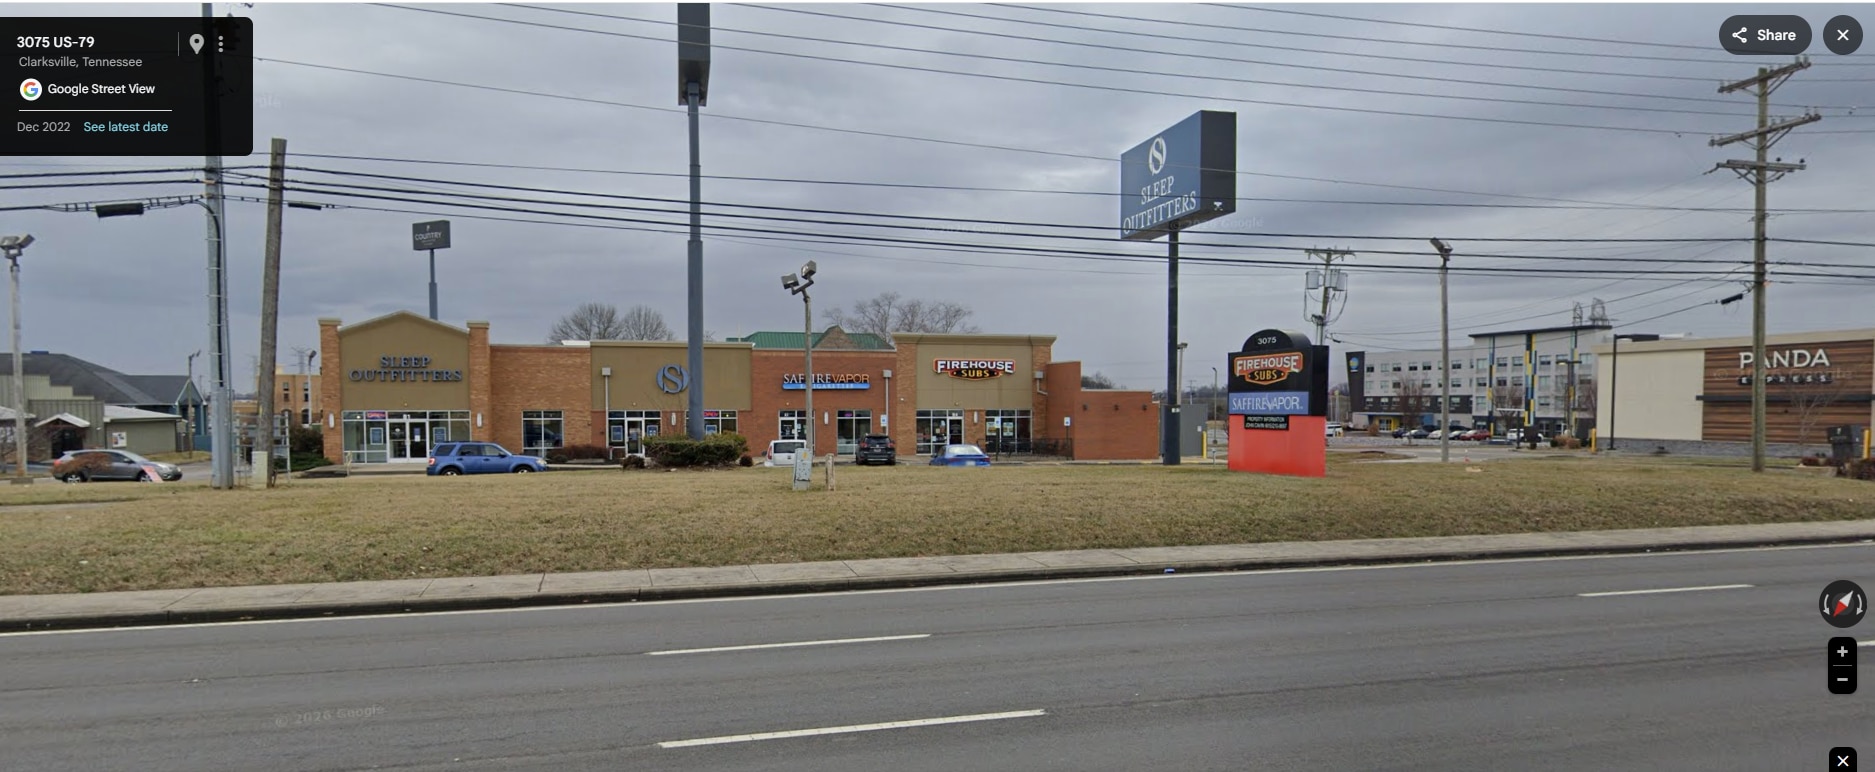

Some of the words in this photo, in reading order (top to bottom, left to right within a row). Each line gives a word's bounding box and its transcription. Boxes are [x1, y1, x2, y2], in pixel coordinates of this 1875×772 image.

[1141, 175, 1175, 205] SLEEP
[1123, 191, 1196, 234] OUTFITTERS
[414, 231, 443, 241] COUNTRY
[1257, 336, 1277, 345] 3075
[380, 355, 432, 368] SLEEP
[937, 360, 1014, 374] FIREHOUSE
[1236, 355, 1299, 376] FIREHOUSE
[349, 370, 463, 382] OUTFITTERS
[783, 373, 870, 384] SAFIREVAPOR
[961, 369, 990, 378] SUBS
[1254, 369, 1278, 381] SUBS
[1741, 374, 1827, 384] EPRESS
